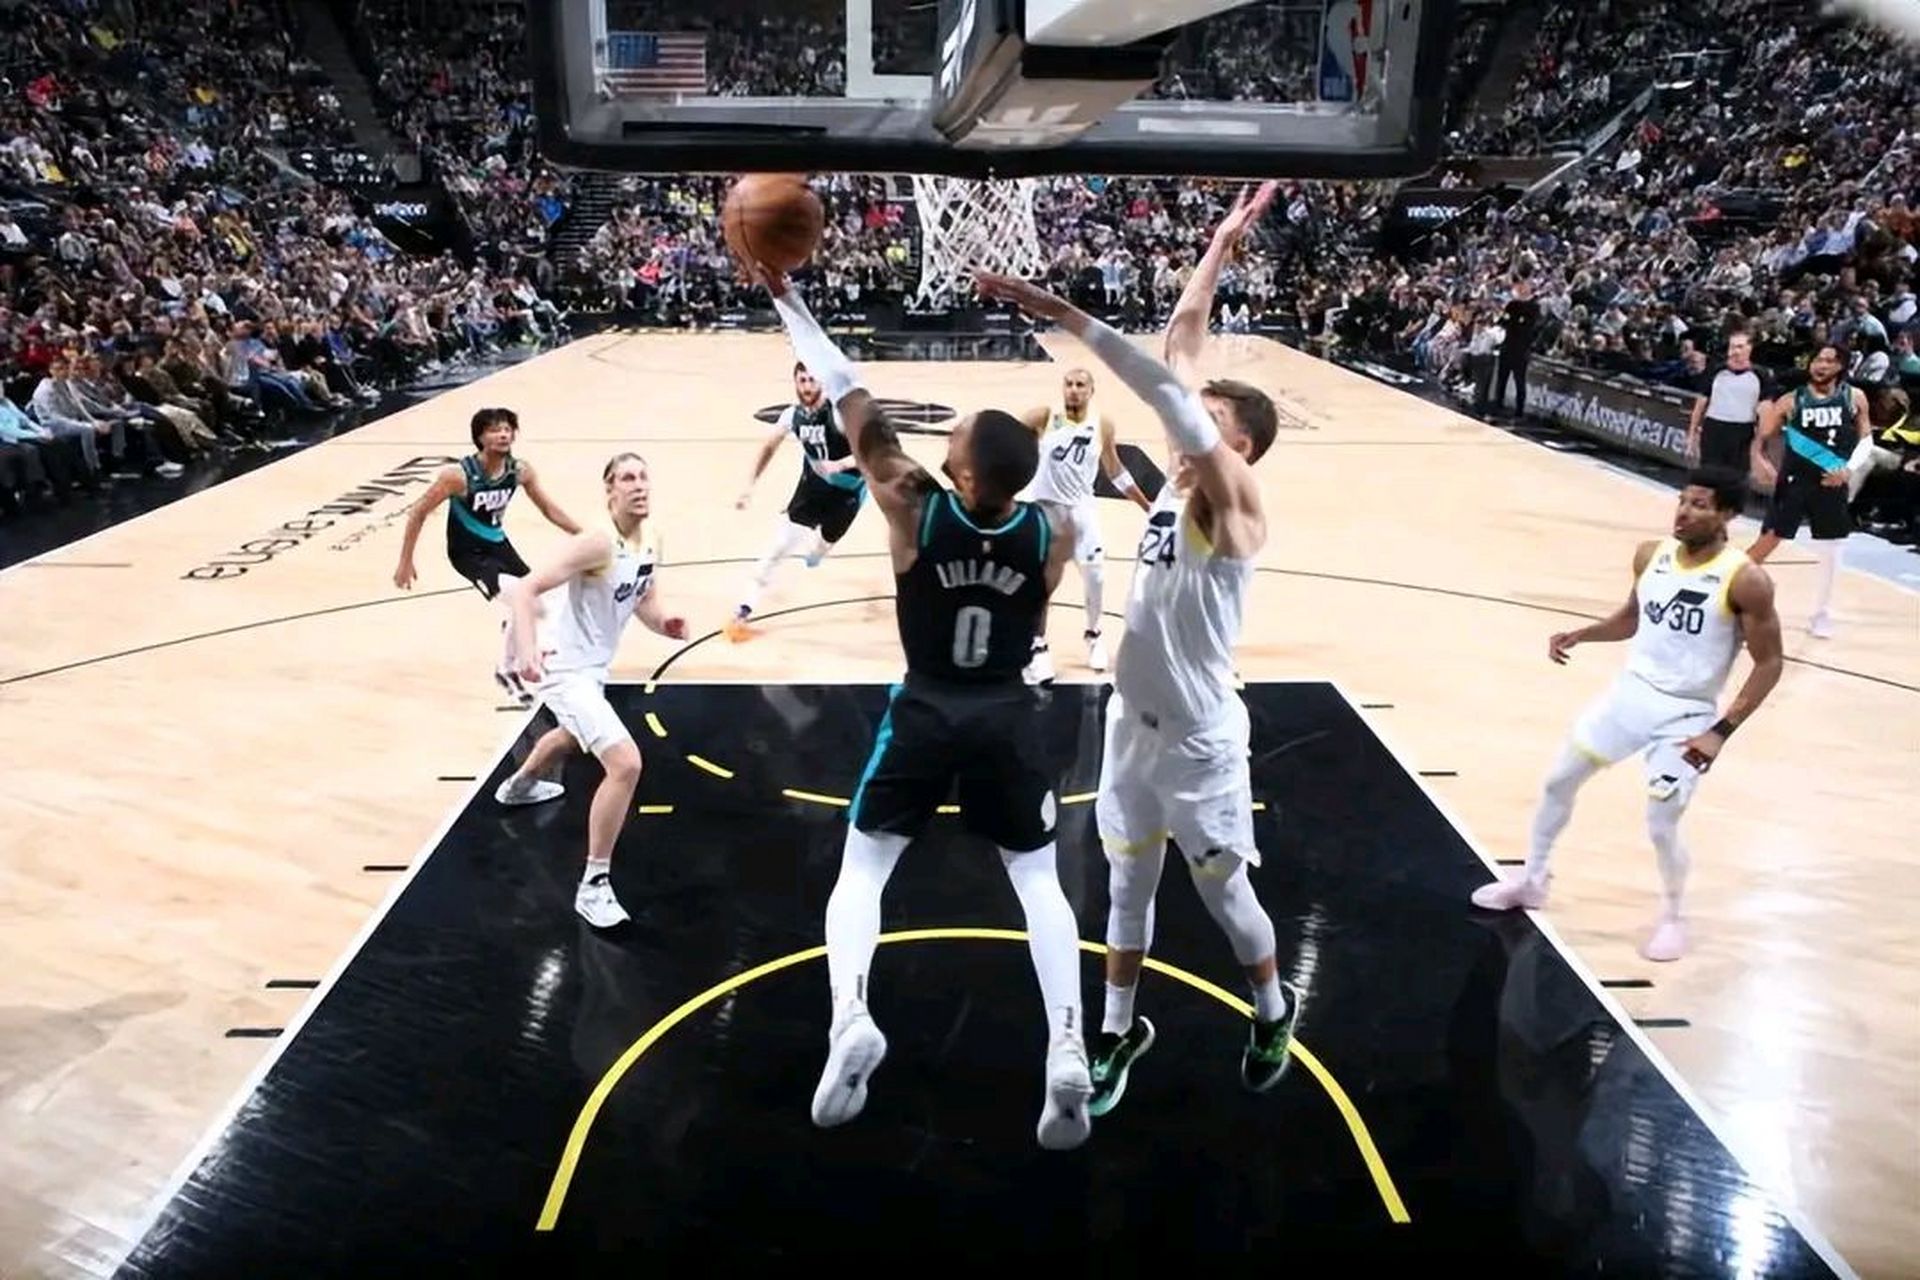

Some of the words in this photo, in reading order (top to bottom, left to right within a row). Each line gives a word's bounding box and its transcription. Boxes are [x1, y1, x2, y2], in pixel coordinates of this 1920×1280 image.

[1583, 395, 1660, 445] America
[1802, 406, 1842, 428] PDX
[1139, 528, 1175, 570] 24
[952, 605, 992, 668] 0
[1668, 602, 1705, 634] 30
